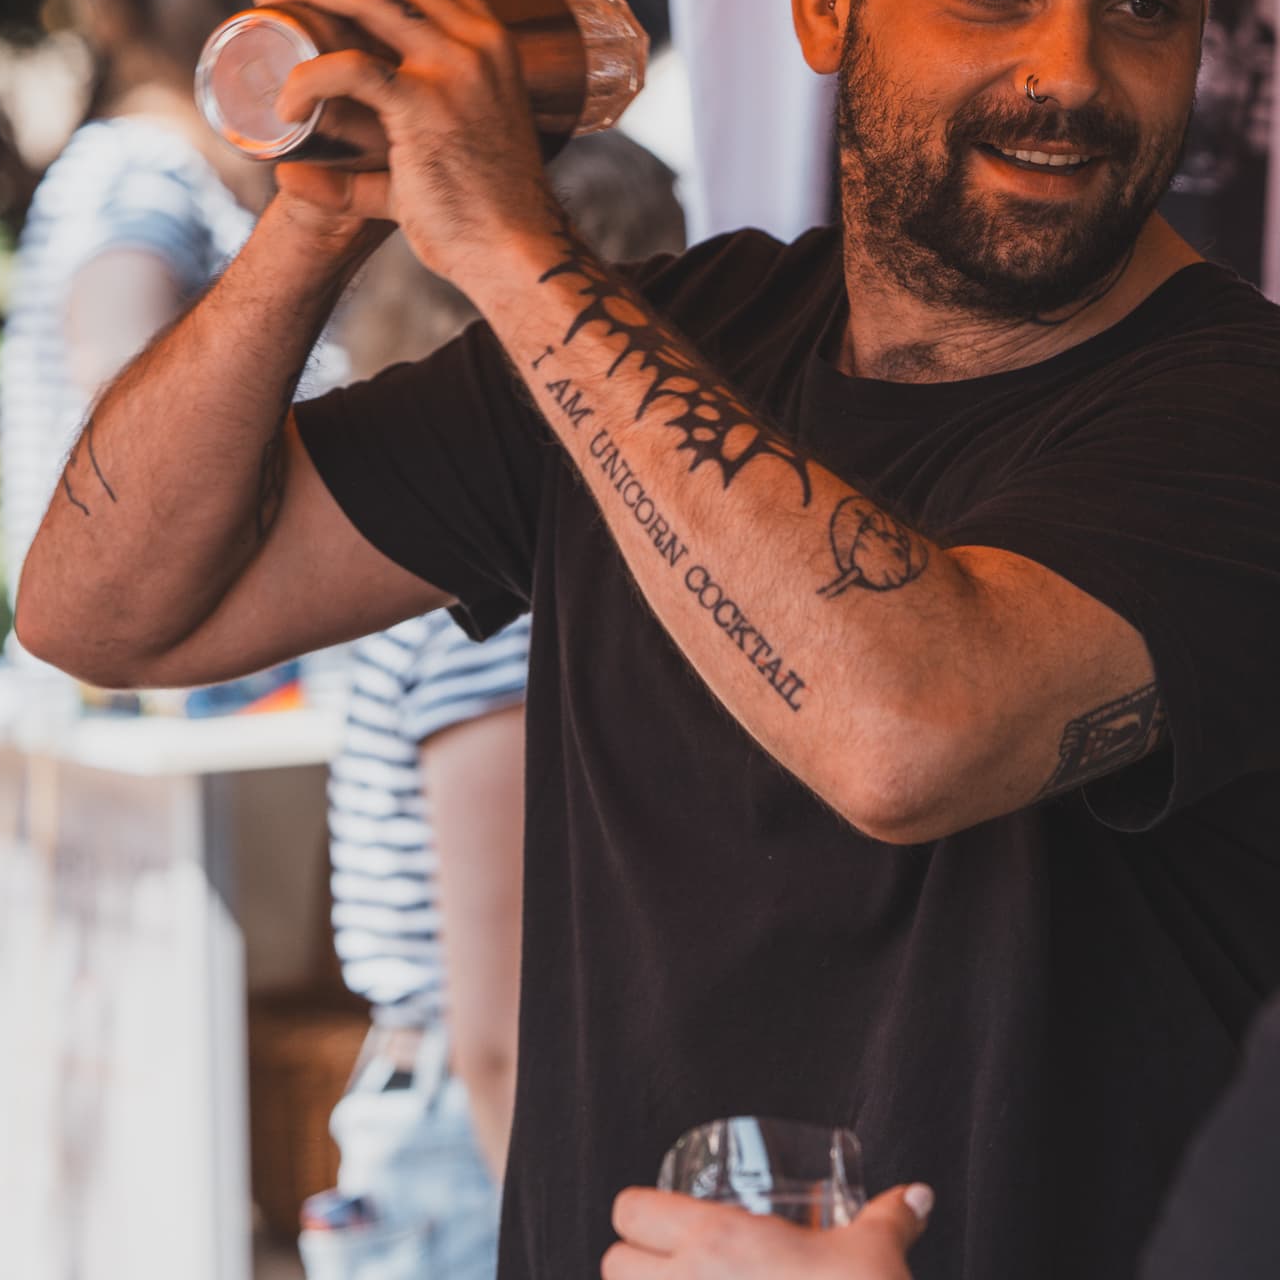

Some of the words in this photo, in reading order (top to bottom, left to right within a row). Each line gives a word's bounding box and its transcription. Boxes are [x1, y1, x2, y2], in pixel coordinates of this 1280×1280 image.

[531, 345, 555, 371] I
[545, 377, 595, 428] AM
[588, 428, 689, 569] UNICORN
[684, 564, 807, 713] COCKTAIL
